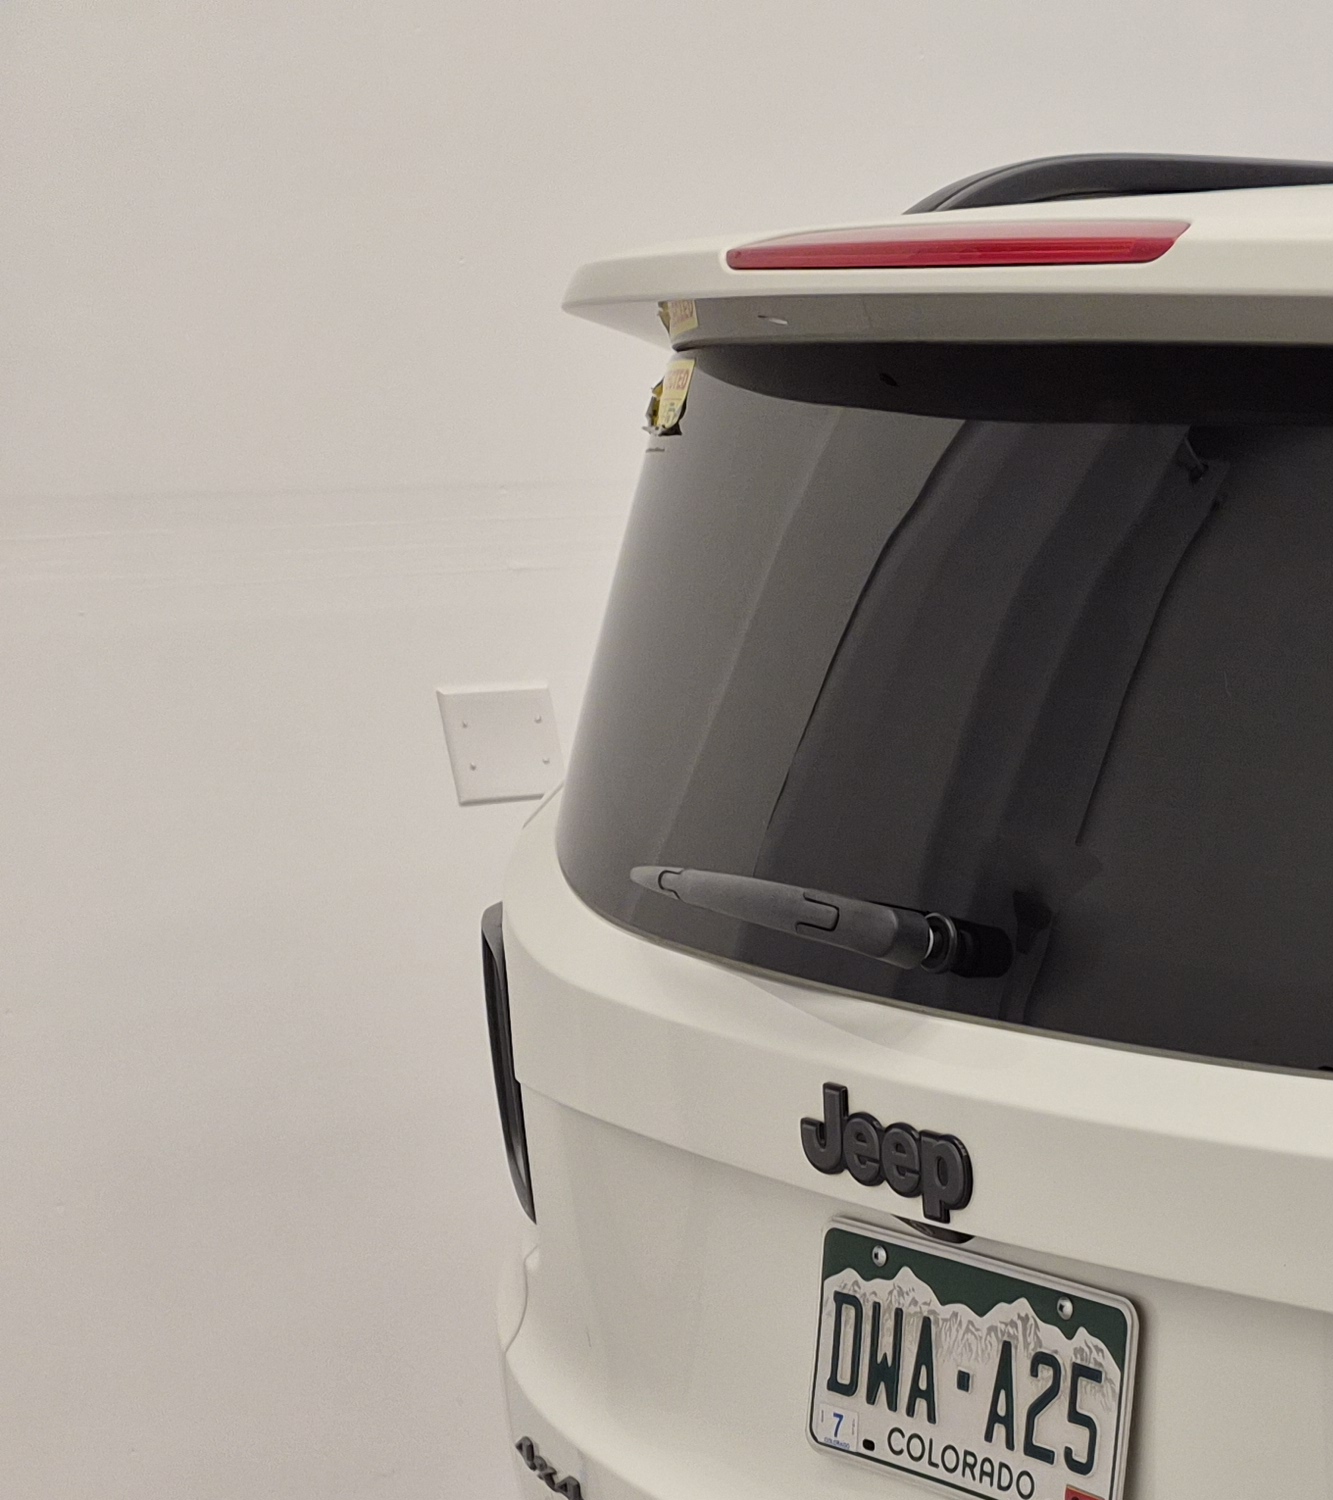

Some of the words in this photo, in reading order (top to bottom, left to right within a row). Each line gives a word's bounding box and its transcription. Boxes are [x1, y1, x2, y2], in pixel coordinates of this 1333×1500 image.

[800, 1082, 974, 1224] Jeep
[833, 1411, 844, 1438] 7
[887, 1426, 1036, 1500] COLORADO
